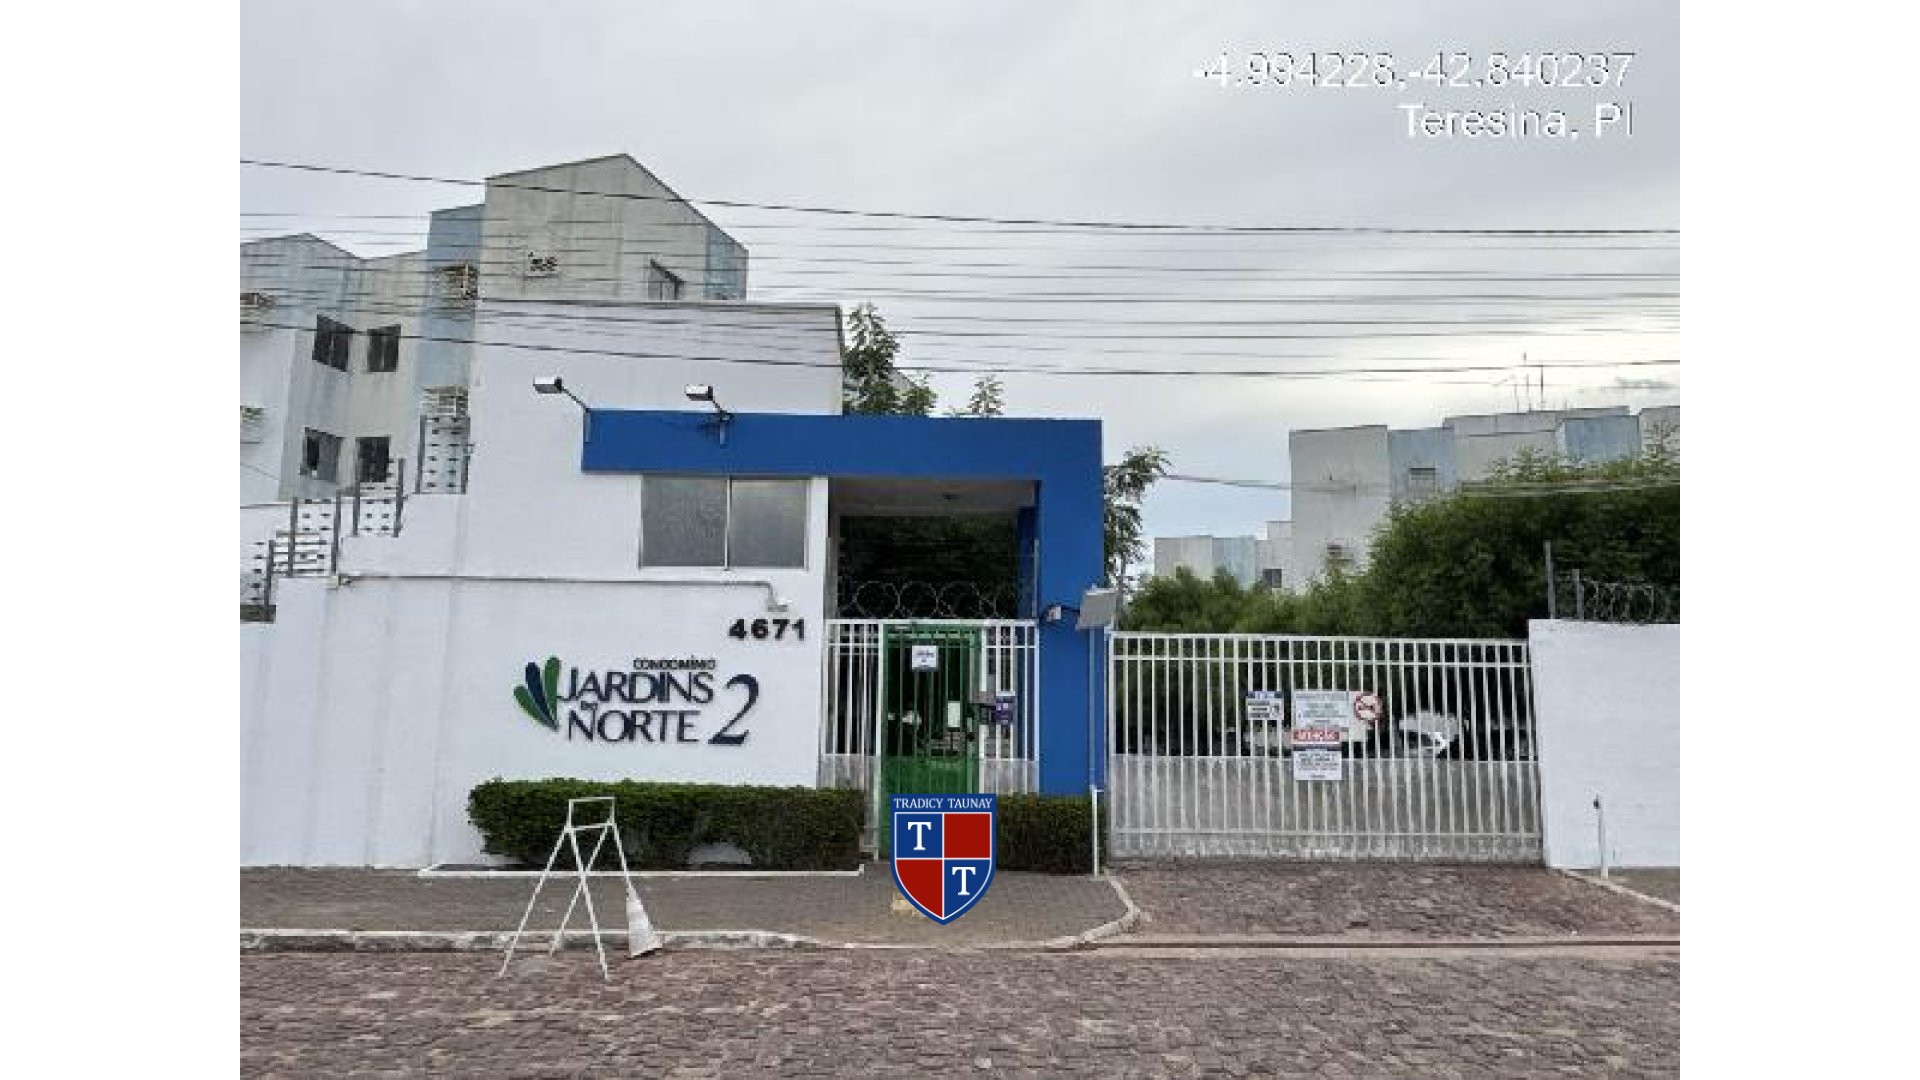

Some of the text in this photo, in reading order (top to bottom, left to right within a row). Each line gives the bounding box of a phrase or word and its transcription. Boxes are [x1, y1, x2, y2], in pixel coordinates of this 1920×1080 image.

[728, 618, 806, 641] 4671
[557, 667, 714, 703] JARDINS
[568, 710, 700, 742] NORTE
[708, 674, 760, 745] 2
